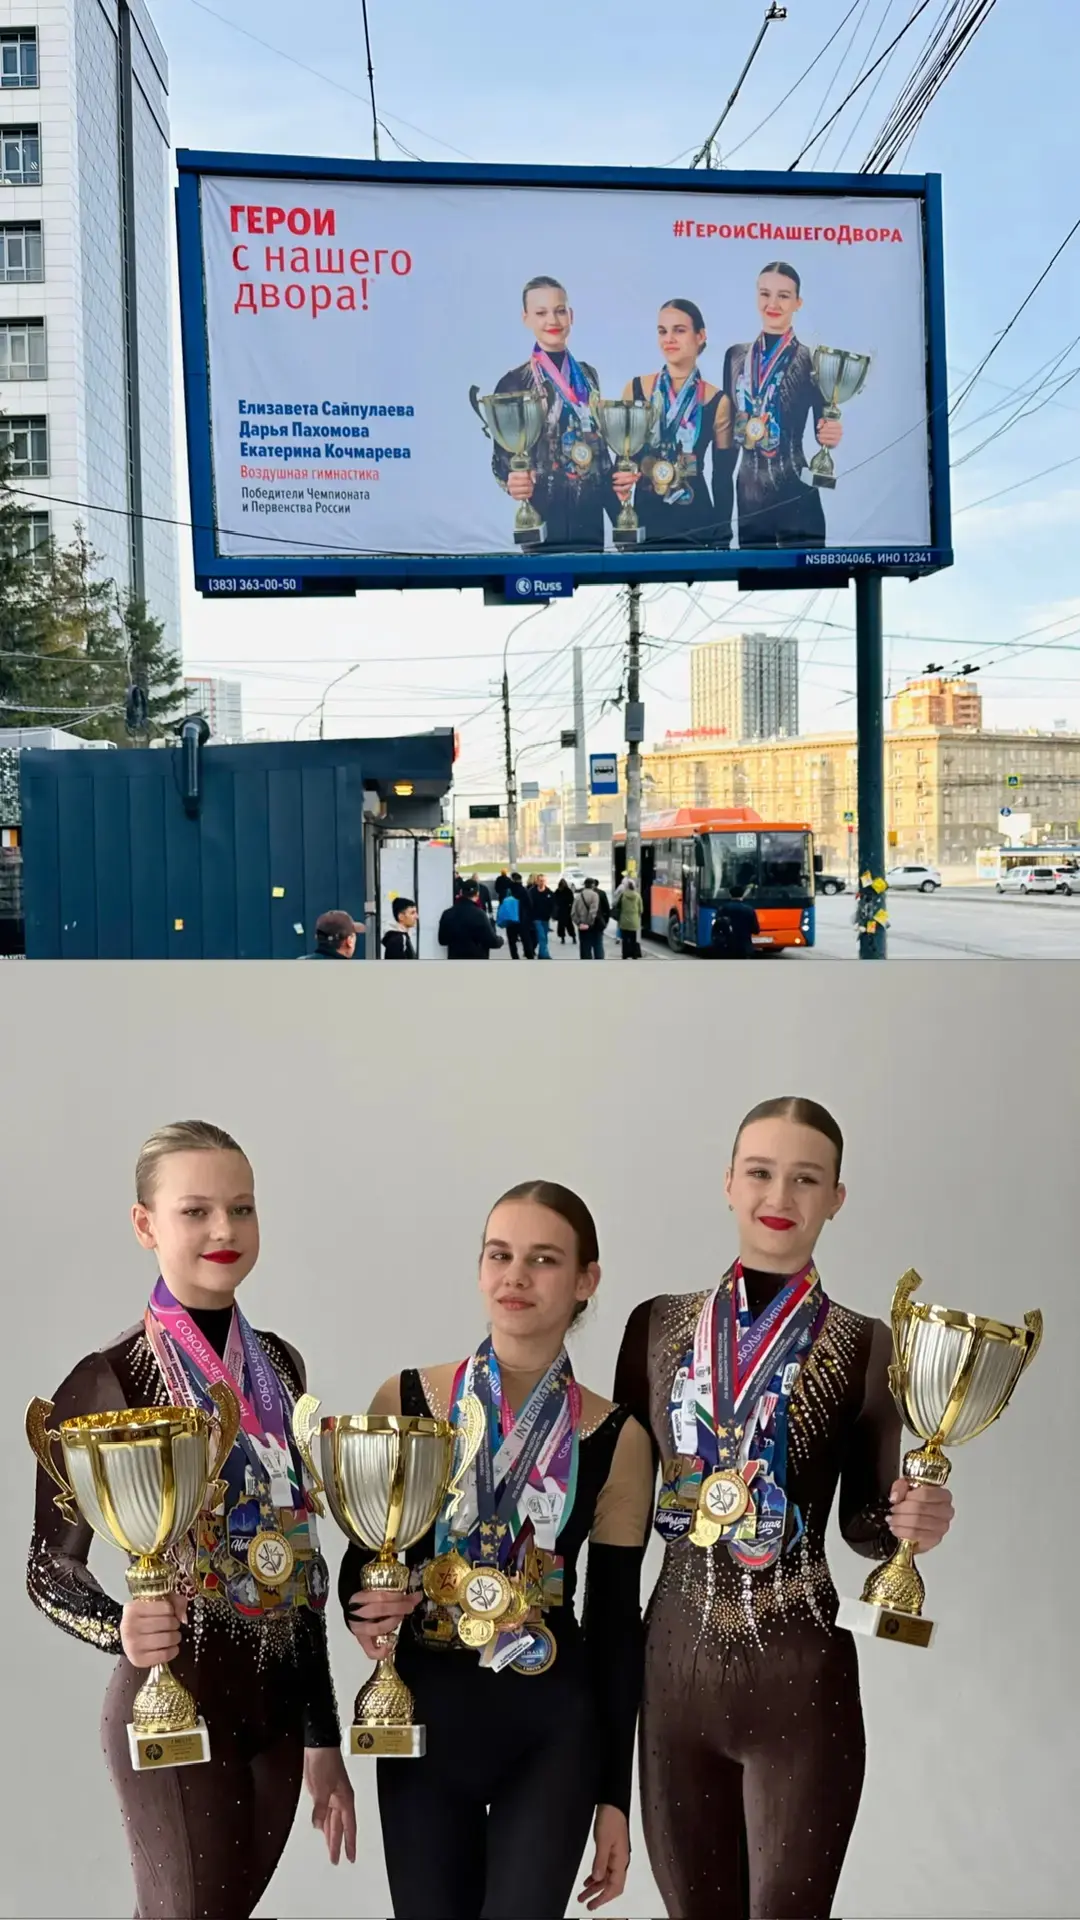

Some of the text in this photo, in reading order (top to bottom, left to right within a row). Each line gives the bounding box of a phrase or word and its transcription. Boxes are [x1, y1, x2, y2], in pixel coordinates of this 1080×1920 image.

[230, 205, 336, 236] ГЕРОИ
[232, 244, 412, 276] с нашего
[234, 278, 369, 319] двора!
[238, 400, 415, 420] Елизавета Сайпулаева
[239, 421, 370, 440] Дарья Пахомова
[240, 442, 411, 462] Екатерина Кочмарева
[240, 465, 380, 483] Воздушная гимнастика
[241, 487, 370, 500] Победители Чемпионата
[242, 501, 351, 515] и Первенства России
[877, 552, 900, 563] ИНО
[903, 552, 932, 563] 12341
[208, 578, 296, 592] (383) 363-00-50
[533, 580, 563, 592] Russ
